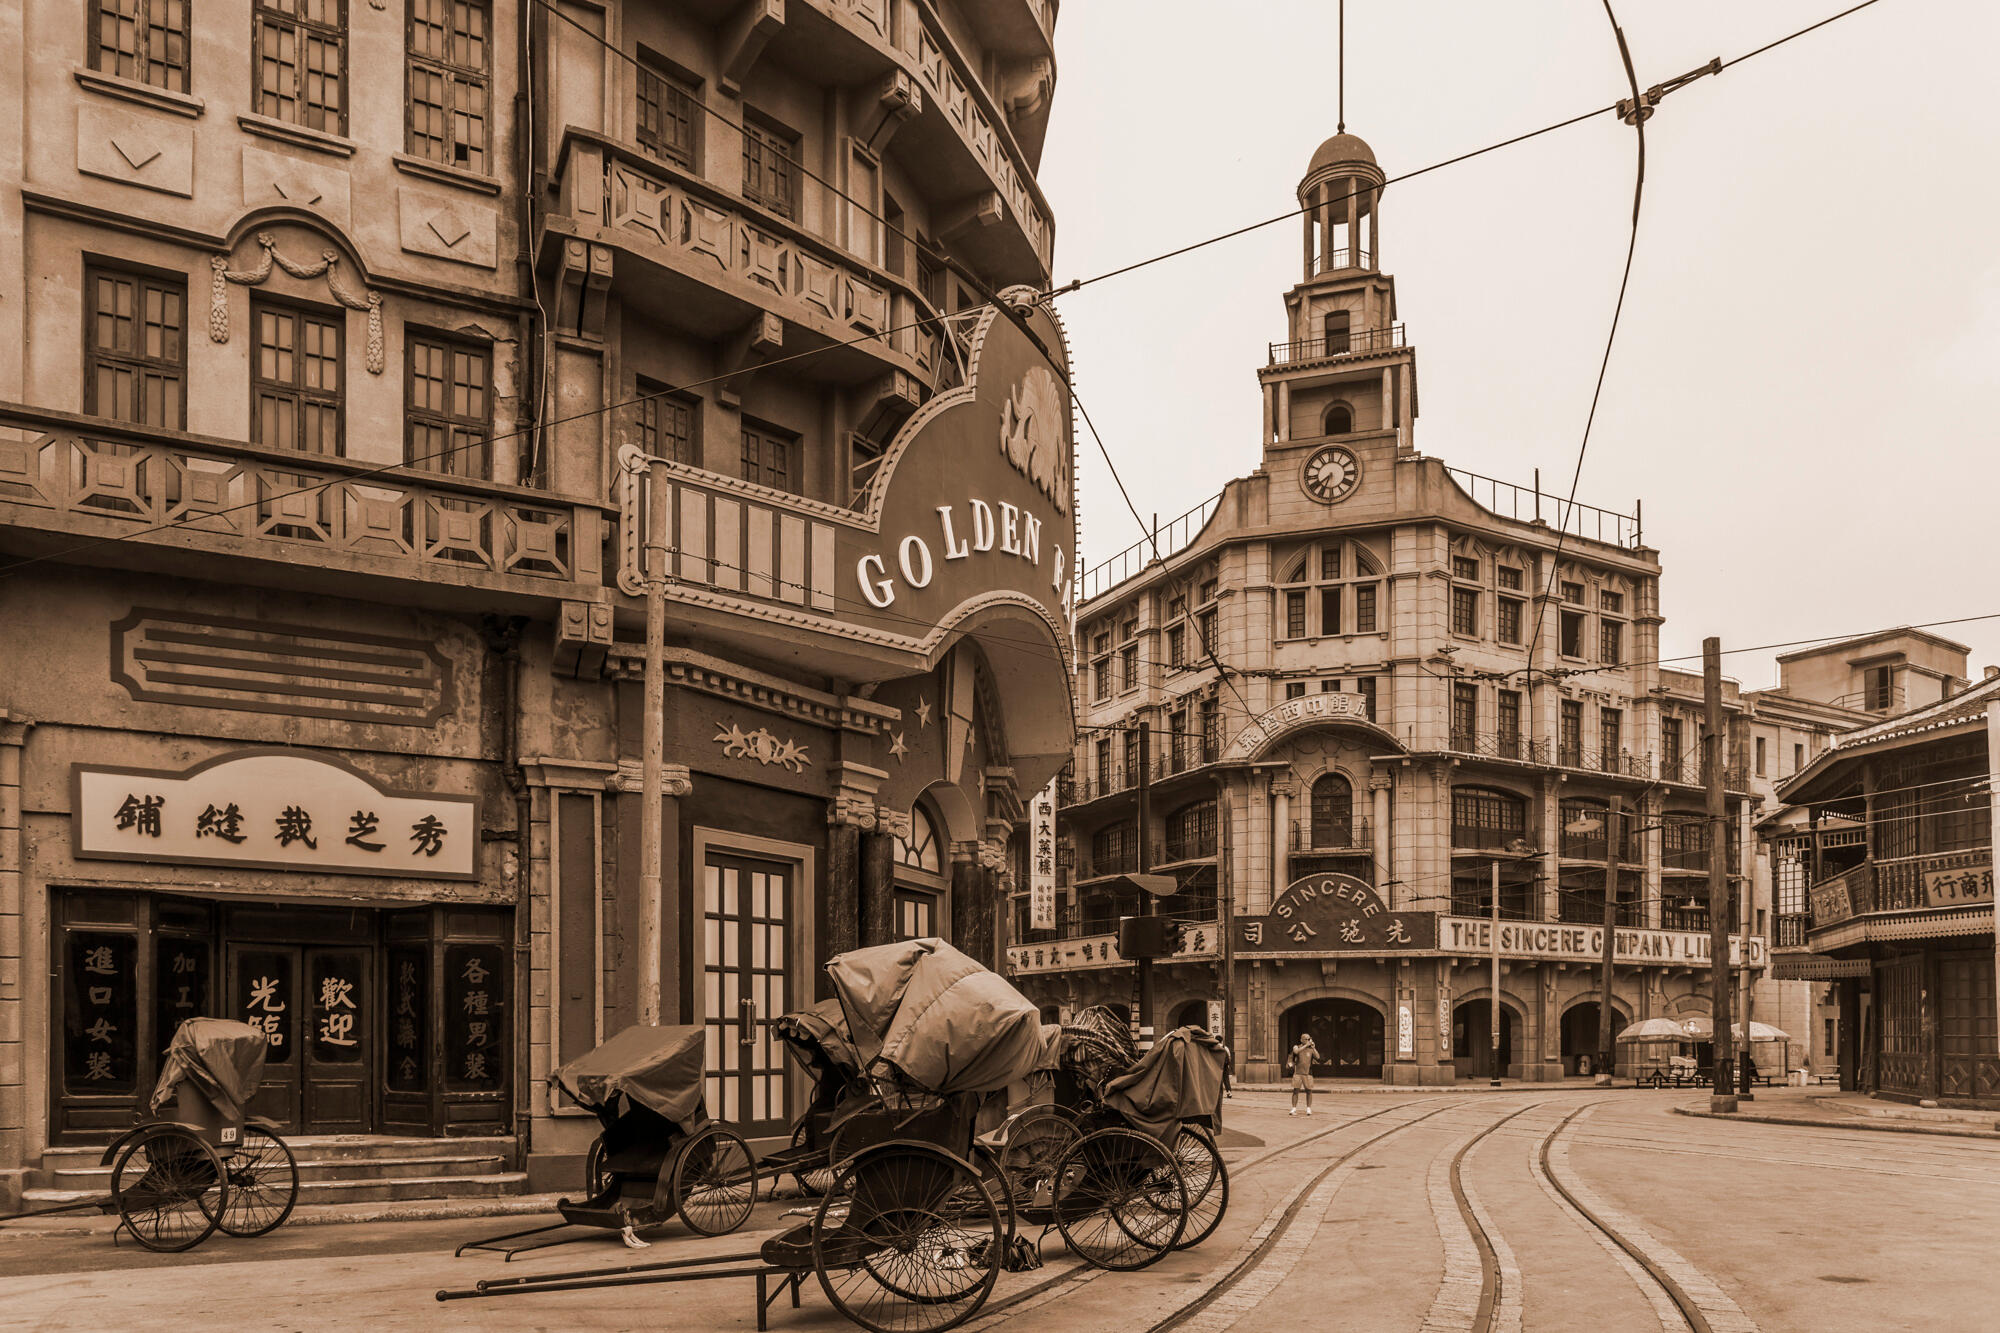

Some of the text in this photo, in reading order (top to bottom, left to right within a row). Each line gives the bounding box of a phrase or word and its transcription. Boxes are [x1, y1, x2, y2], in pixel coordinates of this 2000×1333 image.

[856, 498, 1042, 609] GOLDEN
[1276, 879, 1380, 919] SINCERE
[1451, 922, 1491, 947] THE
[1500, 926, 1586, 953] SINCERE
[1591, 930, 1676, 958] CMPANY
[84, 945, 119, 1081] 進口女裝
[246, 975, 287, 1047] 光臨
[318, 976, 358, 1047] 歡迎
[460, 957, 491, 1081] 各種男裝
[223, 1129, 235, 1140] 49
